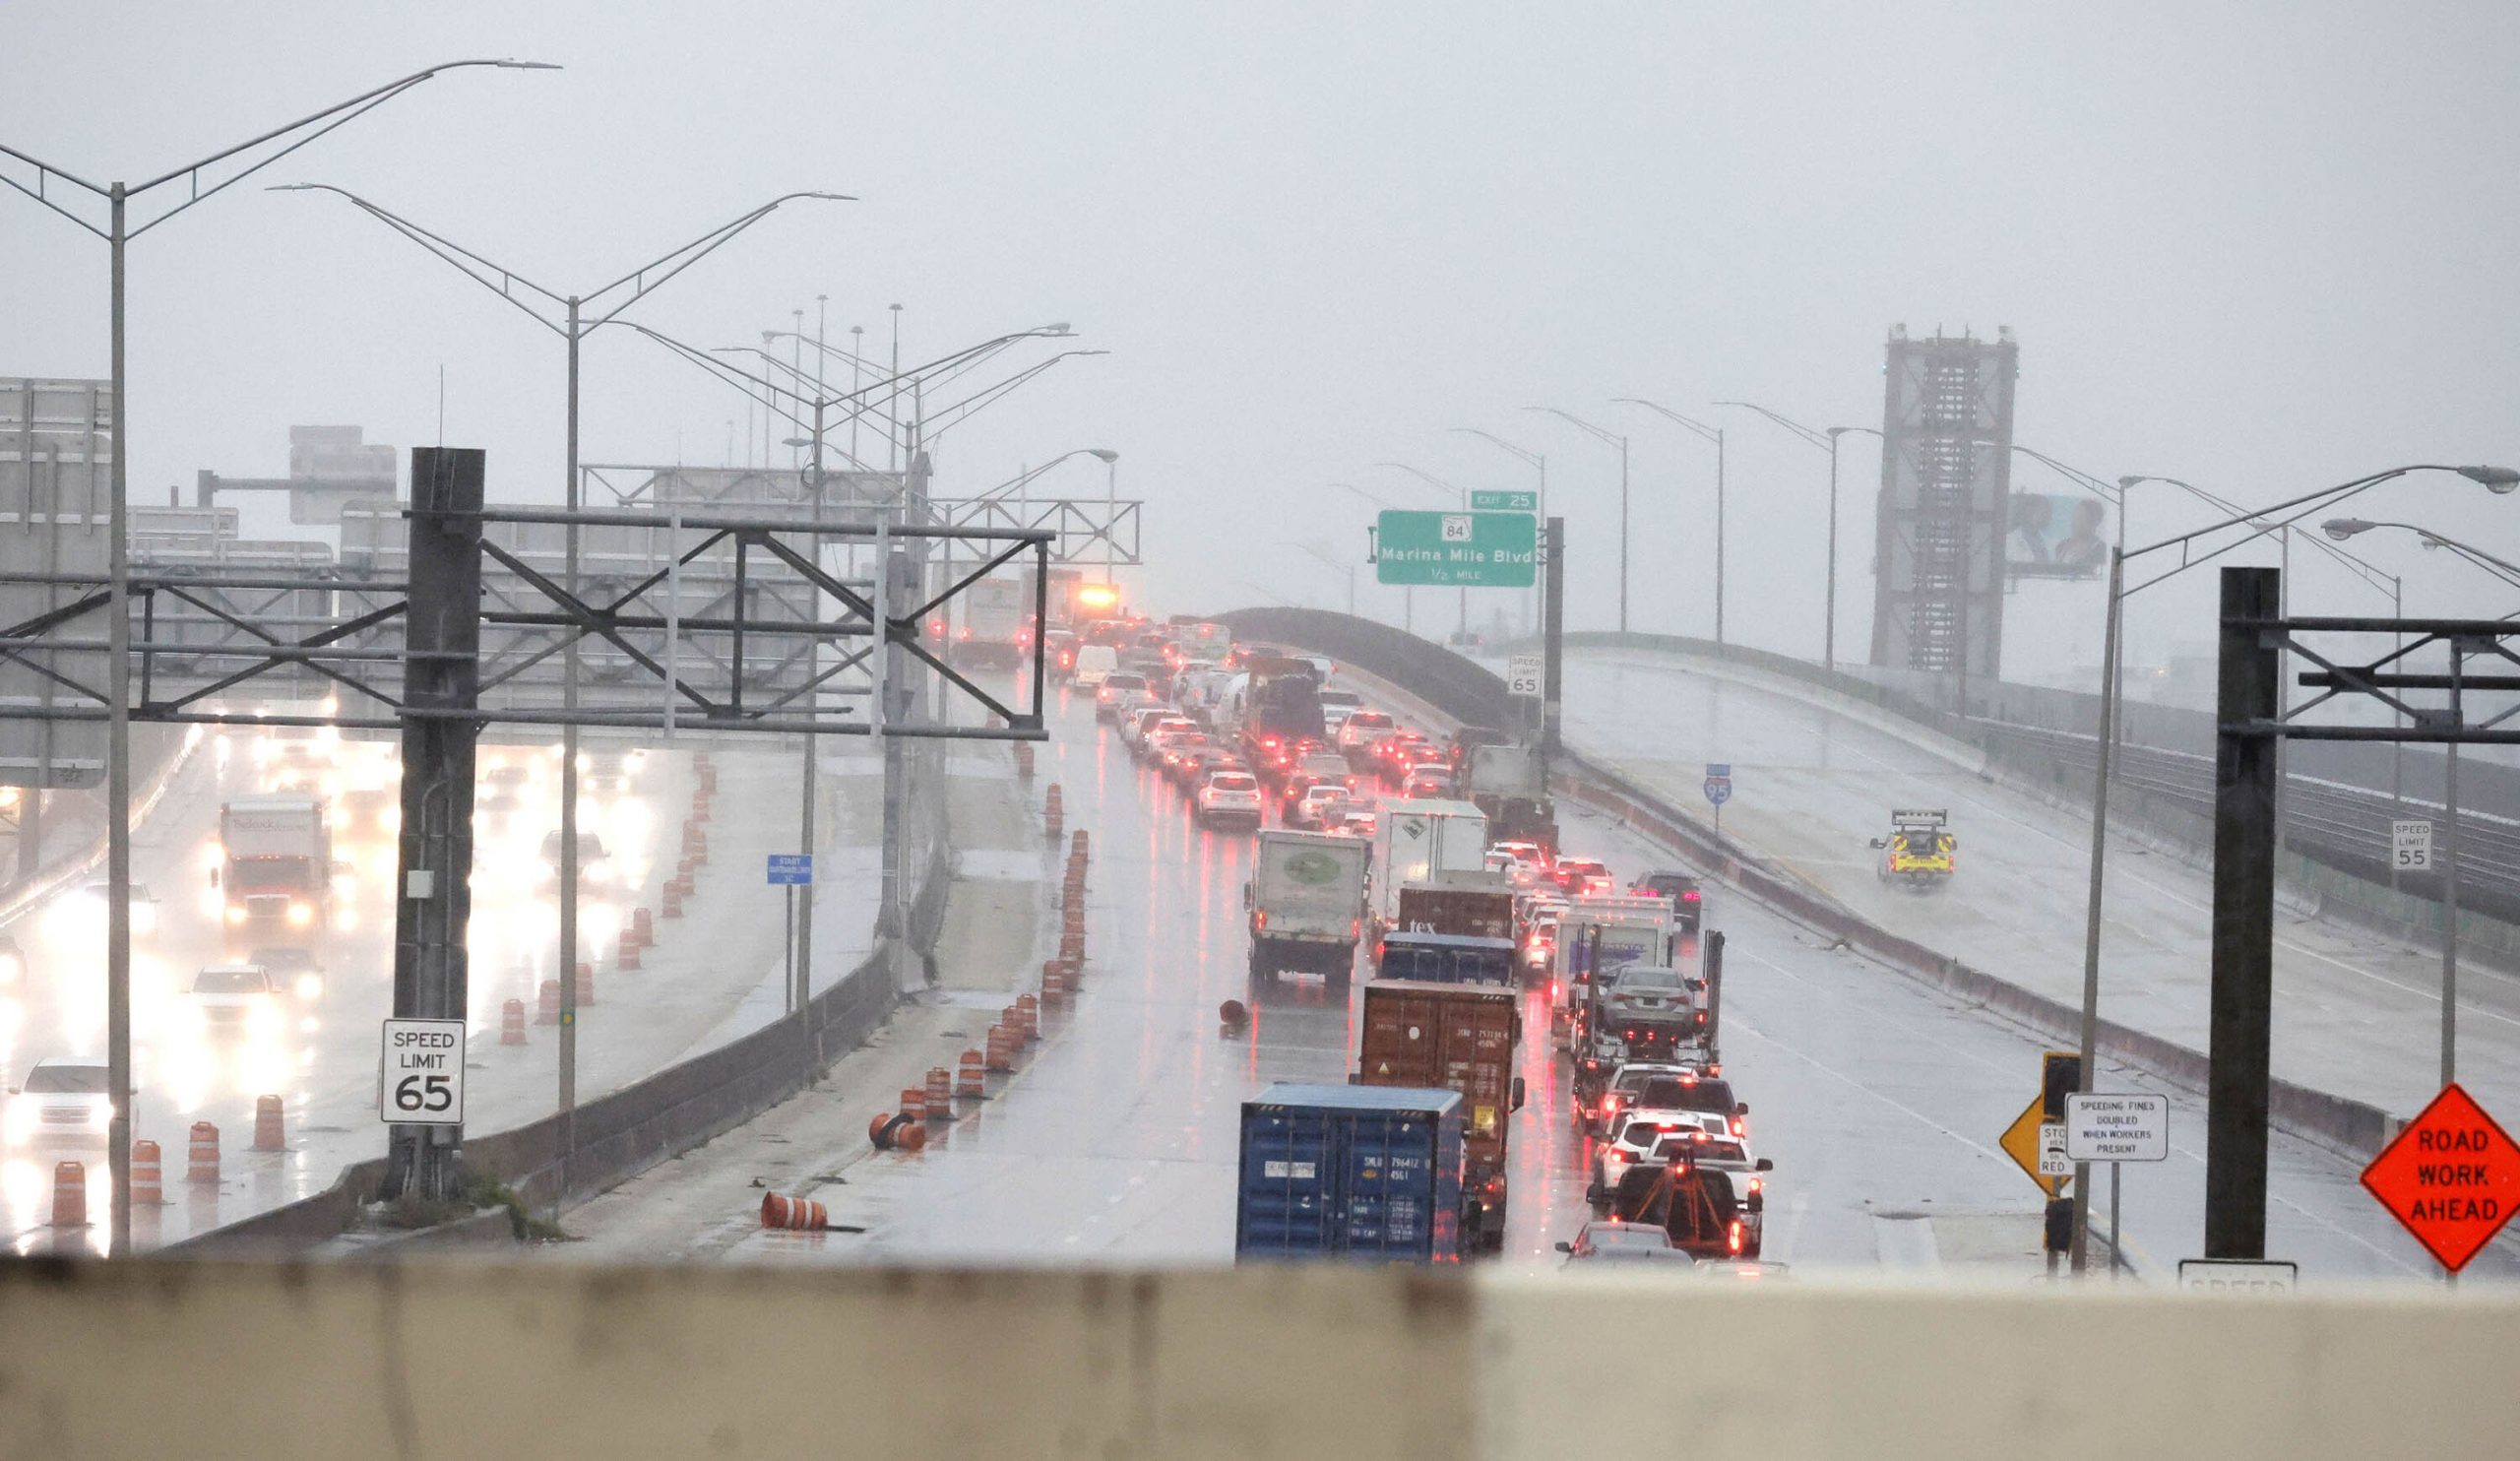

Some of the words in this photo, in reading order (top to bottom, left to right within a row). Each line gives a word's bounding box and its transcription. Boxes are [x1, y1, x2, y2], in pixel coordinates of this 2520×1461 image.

[1511, 495, 1530, 507] 25
[1447, 526, 1464, 537] 84
[1382, 547, 1441, 560] Marina
[1450, 548, 1485, 562] Mile
[1494, 550, 1532, 563] Blvd
[1514, 678, 1536, 691] 65
[1706, 785, 1728, 798] 95
[2395, 825, 2429, 834] SPEED
[2398, 838, 2425, 847] LIMIT
[2399, 850, 2425, 864] 55
[1410, 919, 1436, 935] tex
[394, 1032, 455, 1048] SPEED
[401, 1053, 446, 1069] LIMIT
[396, 1075, 452, 1112] 65
[2080, 1102, 2123, 1111] SPEEDING
[2129, 1102, 2155, 1112] FINES
[2097, 1115, 2138, 1125] DOUBLED
[2045, 1128, 2066, 1138] STO
[2082, 1130, 2109, 1139] WHEN
[2110, 1130, 2152, 1139] WORKERS
[2420, 1130, 2488, 1152] ROAD
[2097, 1144, 2136, 1153] PRESENT
[1391, 1157, 1419, 1168] 796412
[2042, 1162, 2065, 1172] RED
[2418, 1165, 2489, 1186] WORK
[2413, 1198, 2498, 1221] AHEAD
